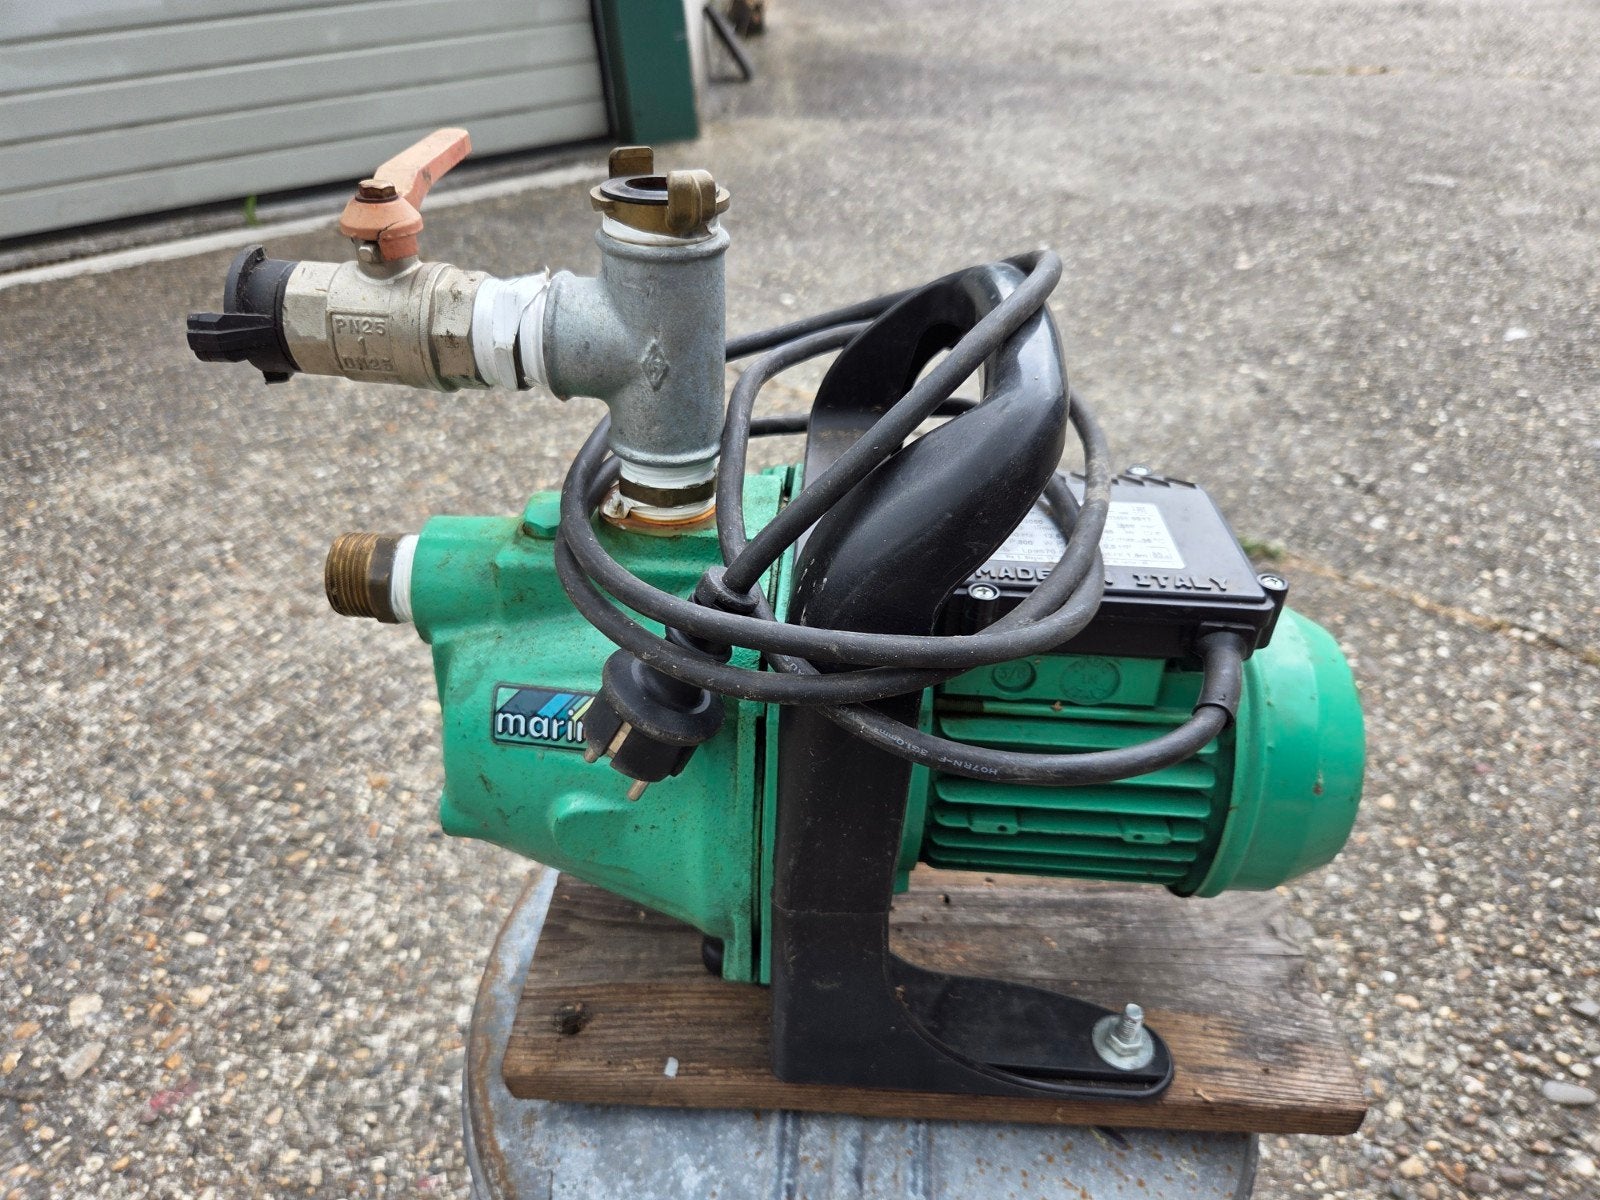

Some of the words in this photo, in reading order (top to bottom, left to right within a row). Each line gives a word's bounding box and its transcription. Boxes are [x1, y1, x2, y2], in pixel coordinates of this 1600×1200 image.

[334, 316, 386, 336] PN25
[974, 566, 1051, 582] MADE
[1132, 573, 1228, 591] ITALY
[937, 756, 998, 776] H07RN-F
